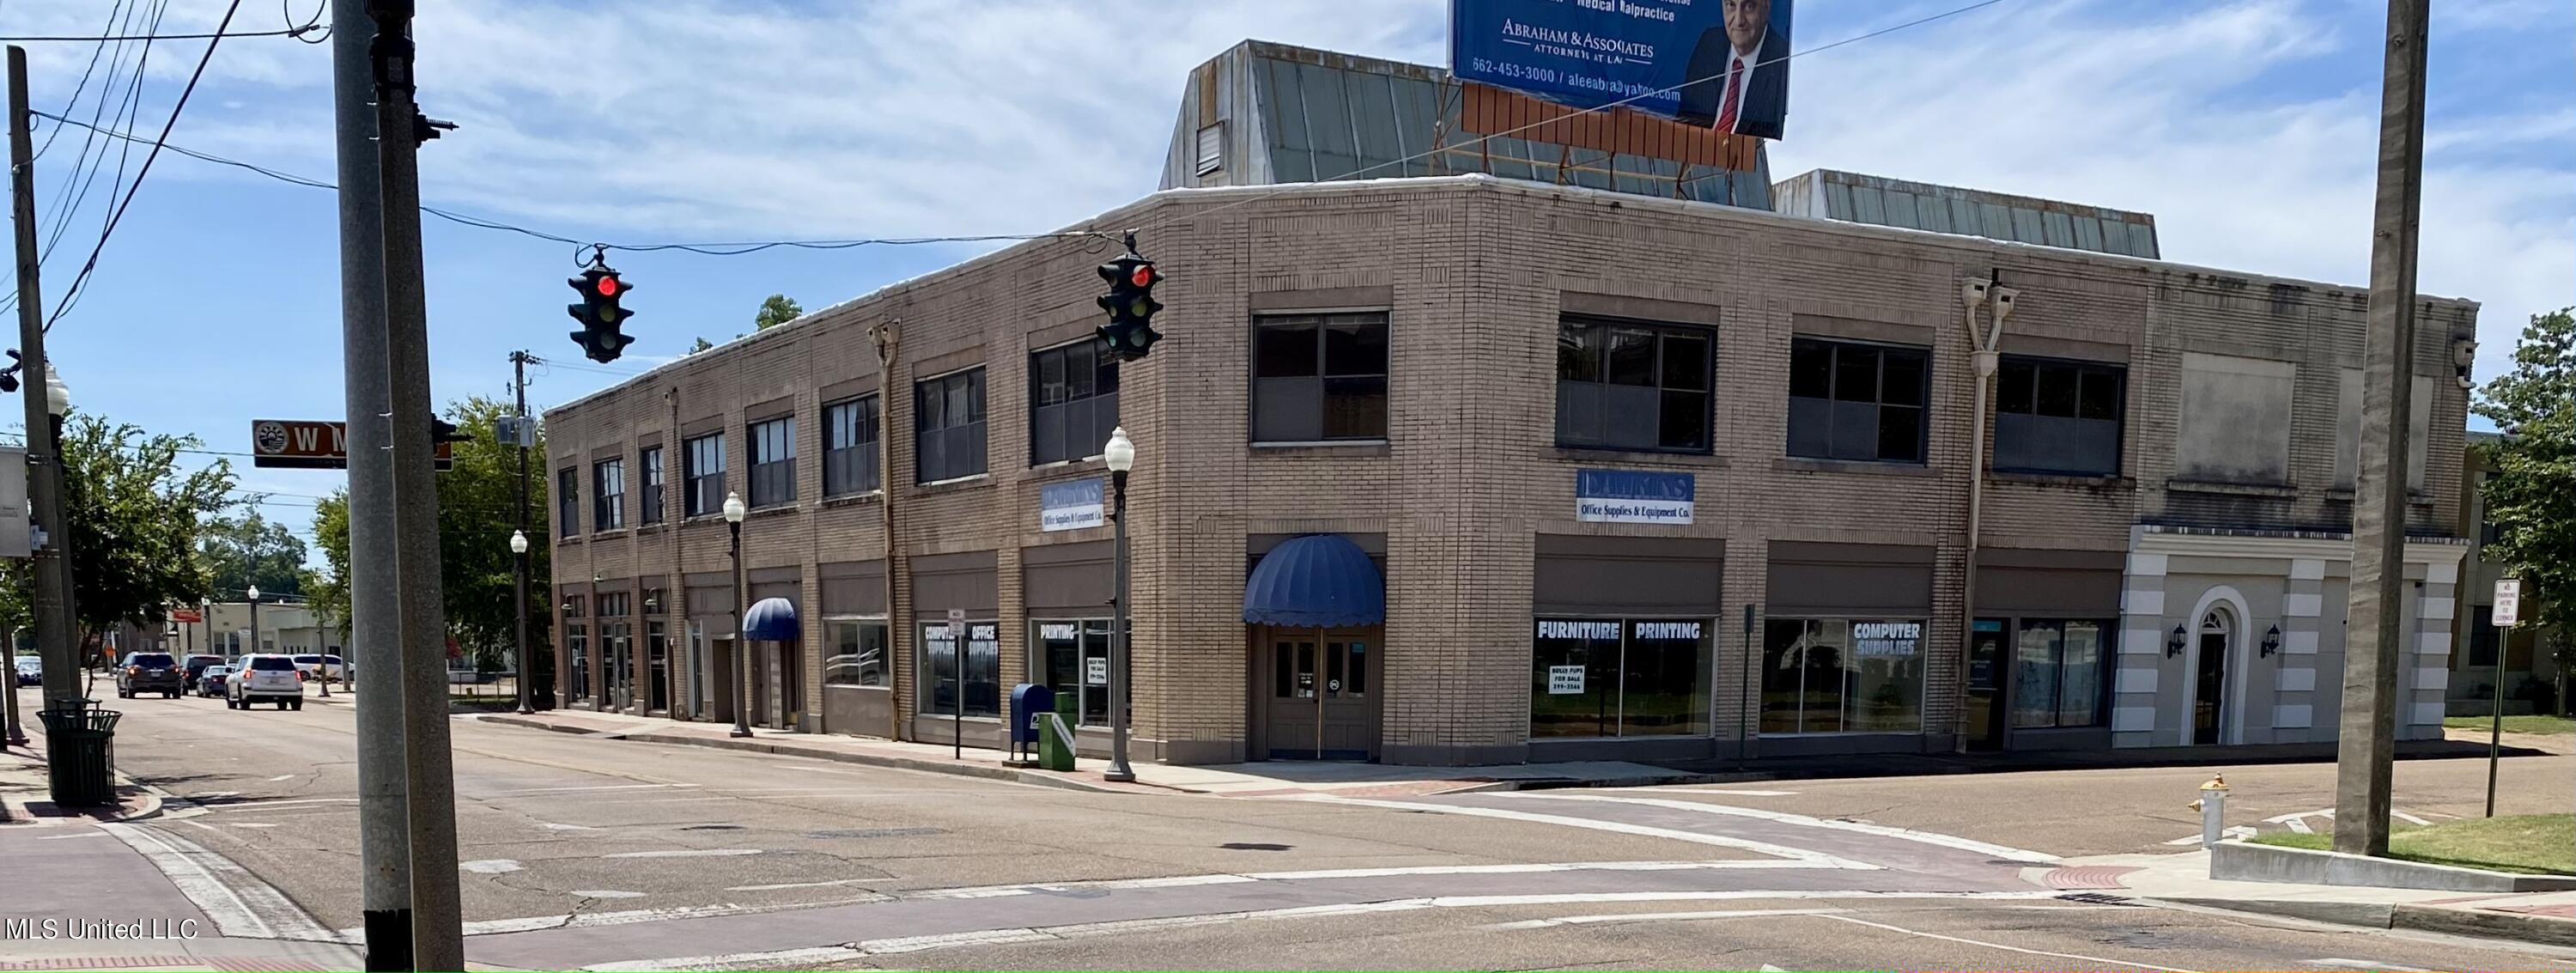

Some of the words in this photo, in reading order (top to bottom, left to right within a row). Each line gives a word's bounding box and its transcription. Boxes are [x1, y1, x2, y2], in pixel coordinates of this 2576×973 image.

[1503, 18, 1567, 44] ABRAHAM
[1571, 32, 1581, 46] &
[1594, 53, 1603, 63] AT
[1473, 57, 1554, 82] 662-453-3000
[295, 427, 318, 452] W
[1581, 504, 1601, 515] Office
[1604, 505, 1631, 519] Supplies
[1634, 506, 1640, 516] &
[1642, 506, 1676, 520] Equipment
[926, 626, 955, 640] COMPUT
[972, 625, 994, 640] OFFICE
[1041, 623, 1074, 639] PRINTING
[1538, 621, 1620, 639] FURNITURE
[1635, 623, 1700, 639] PRINTING
[1855, 623, 1920, 639] COMPUTER
[1856, 640, 1915, 655] SUPPLIES
